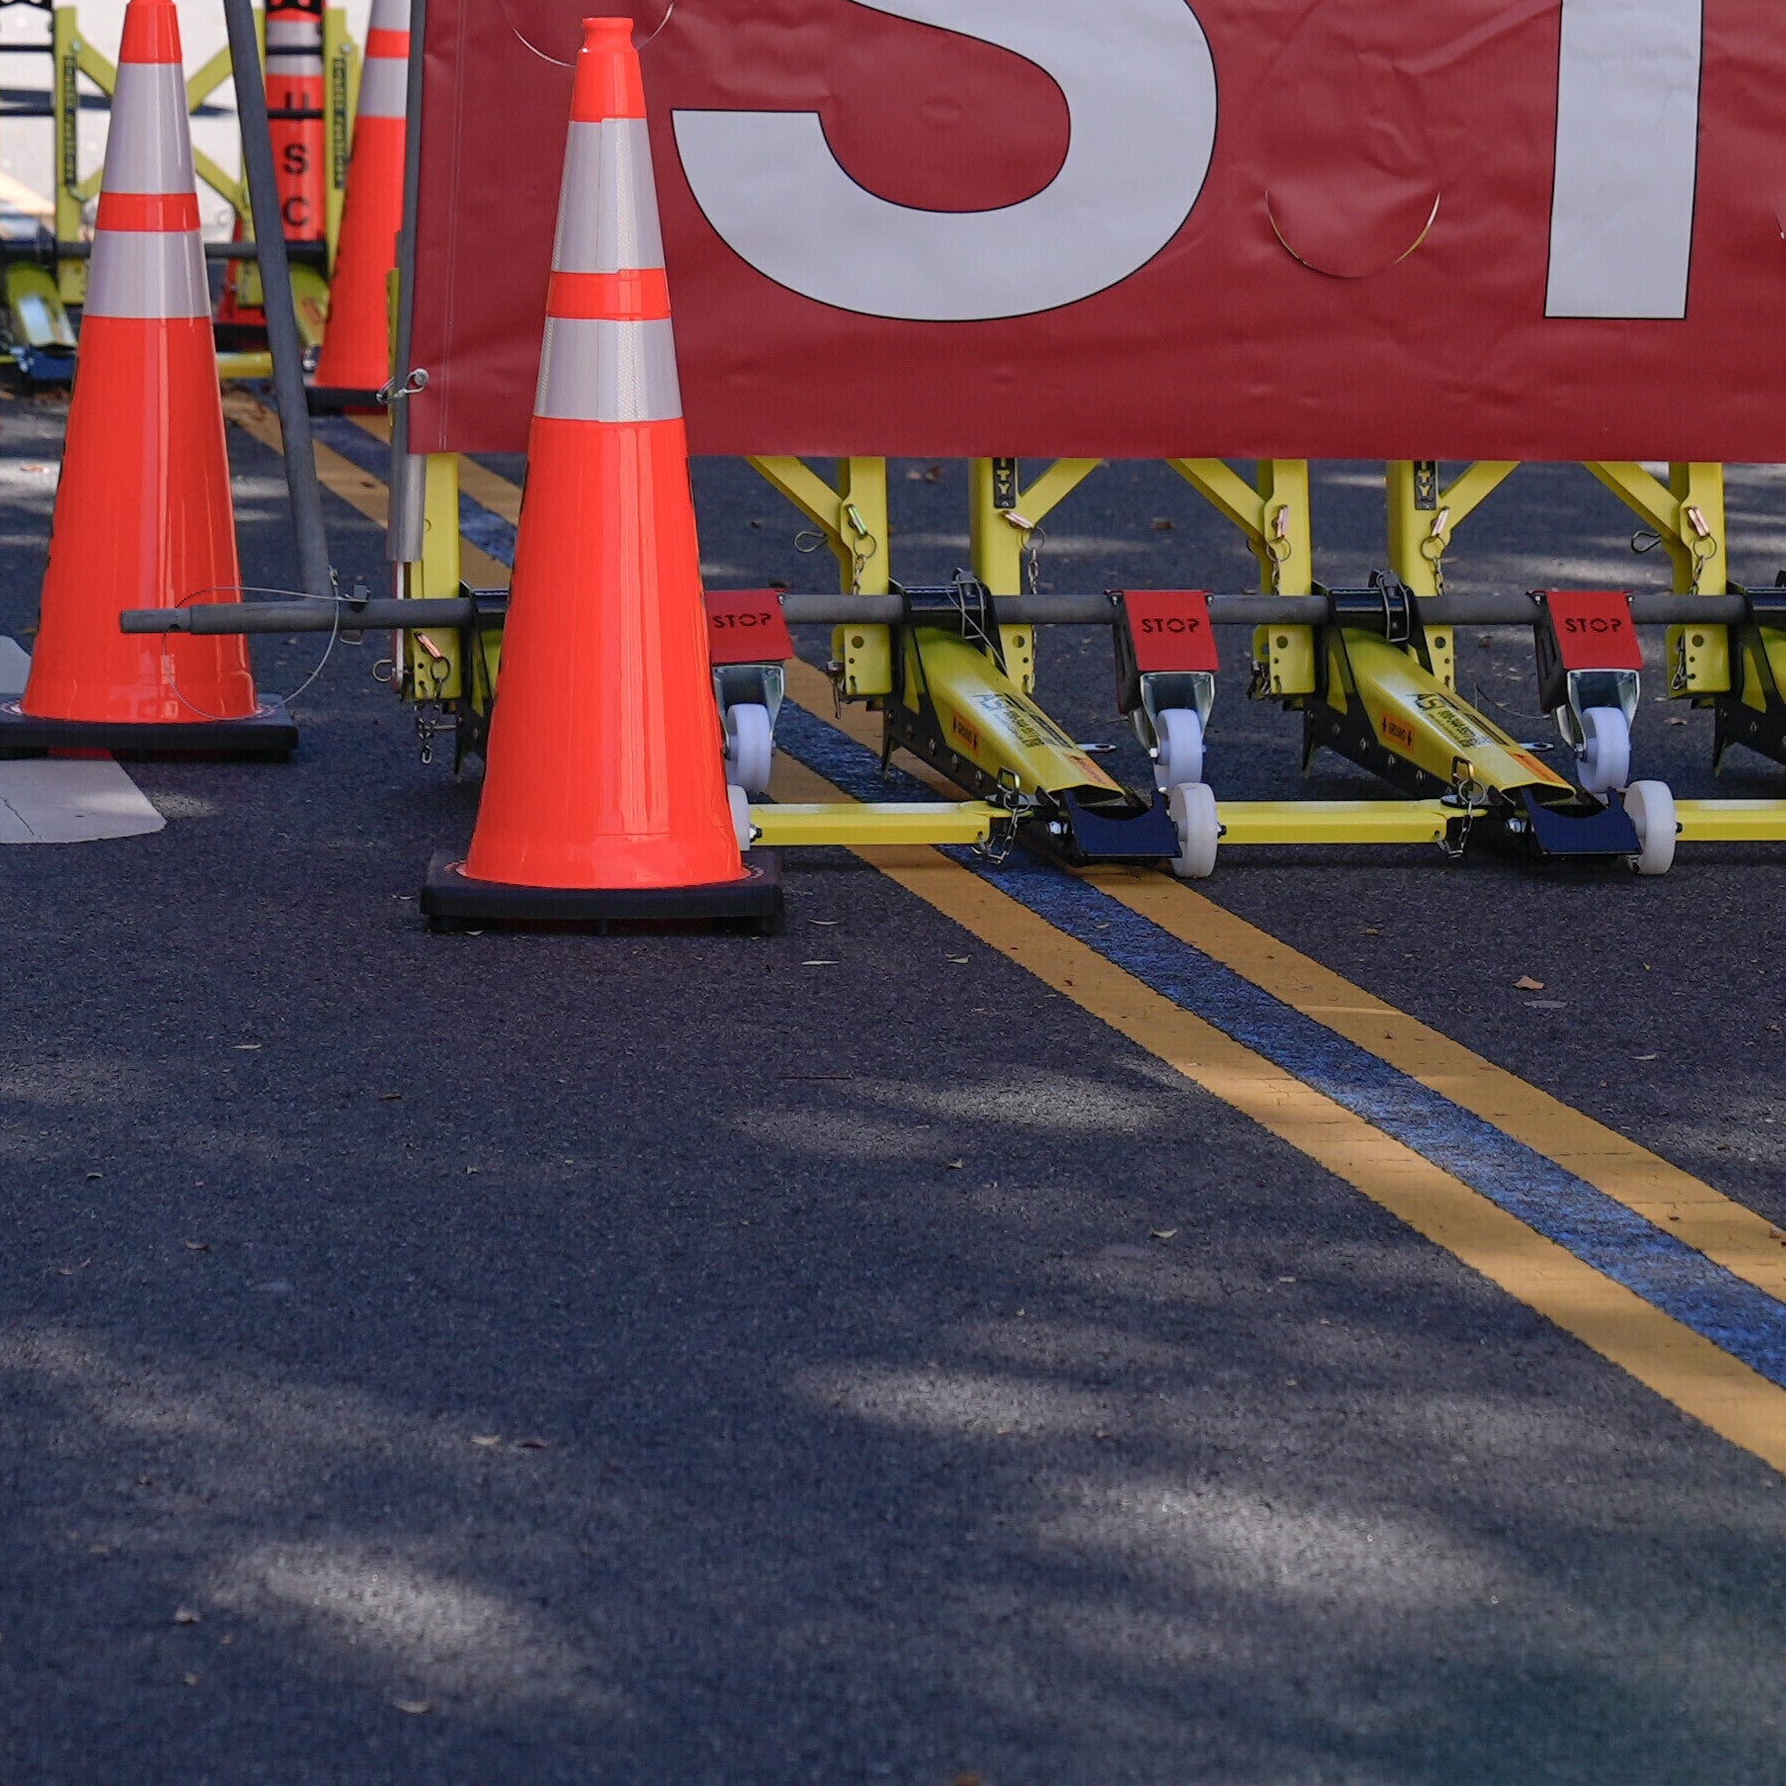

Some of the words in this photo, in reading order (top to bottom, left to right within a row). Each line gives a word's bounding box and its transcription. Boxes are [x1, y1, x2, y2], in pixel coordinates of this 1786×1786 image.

[994, 457, 1011, 495] ITY
[1417, 459, 1433, 498] ITY
[712, 612, 773, 630] STOP
[1140, 616, 1201, 634] STOP
[1564, 616, 1623, 634] STOP
